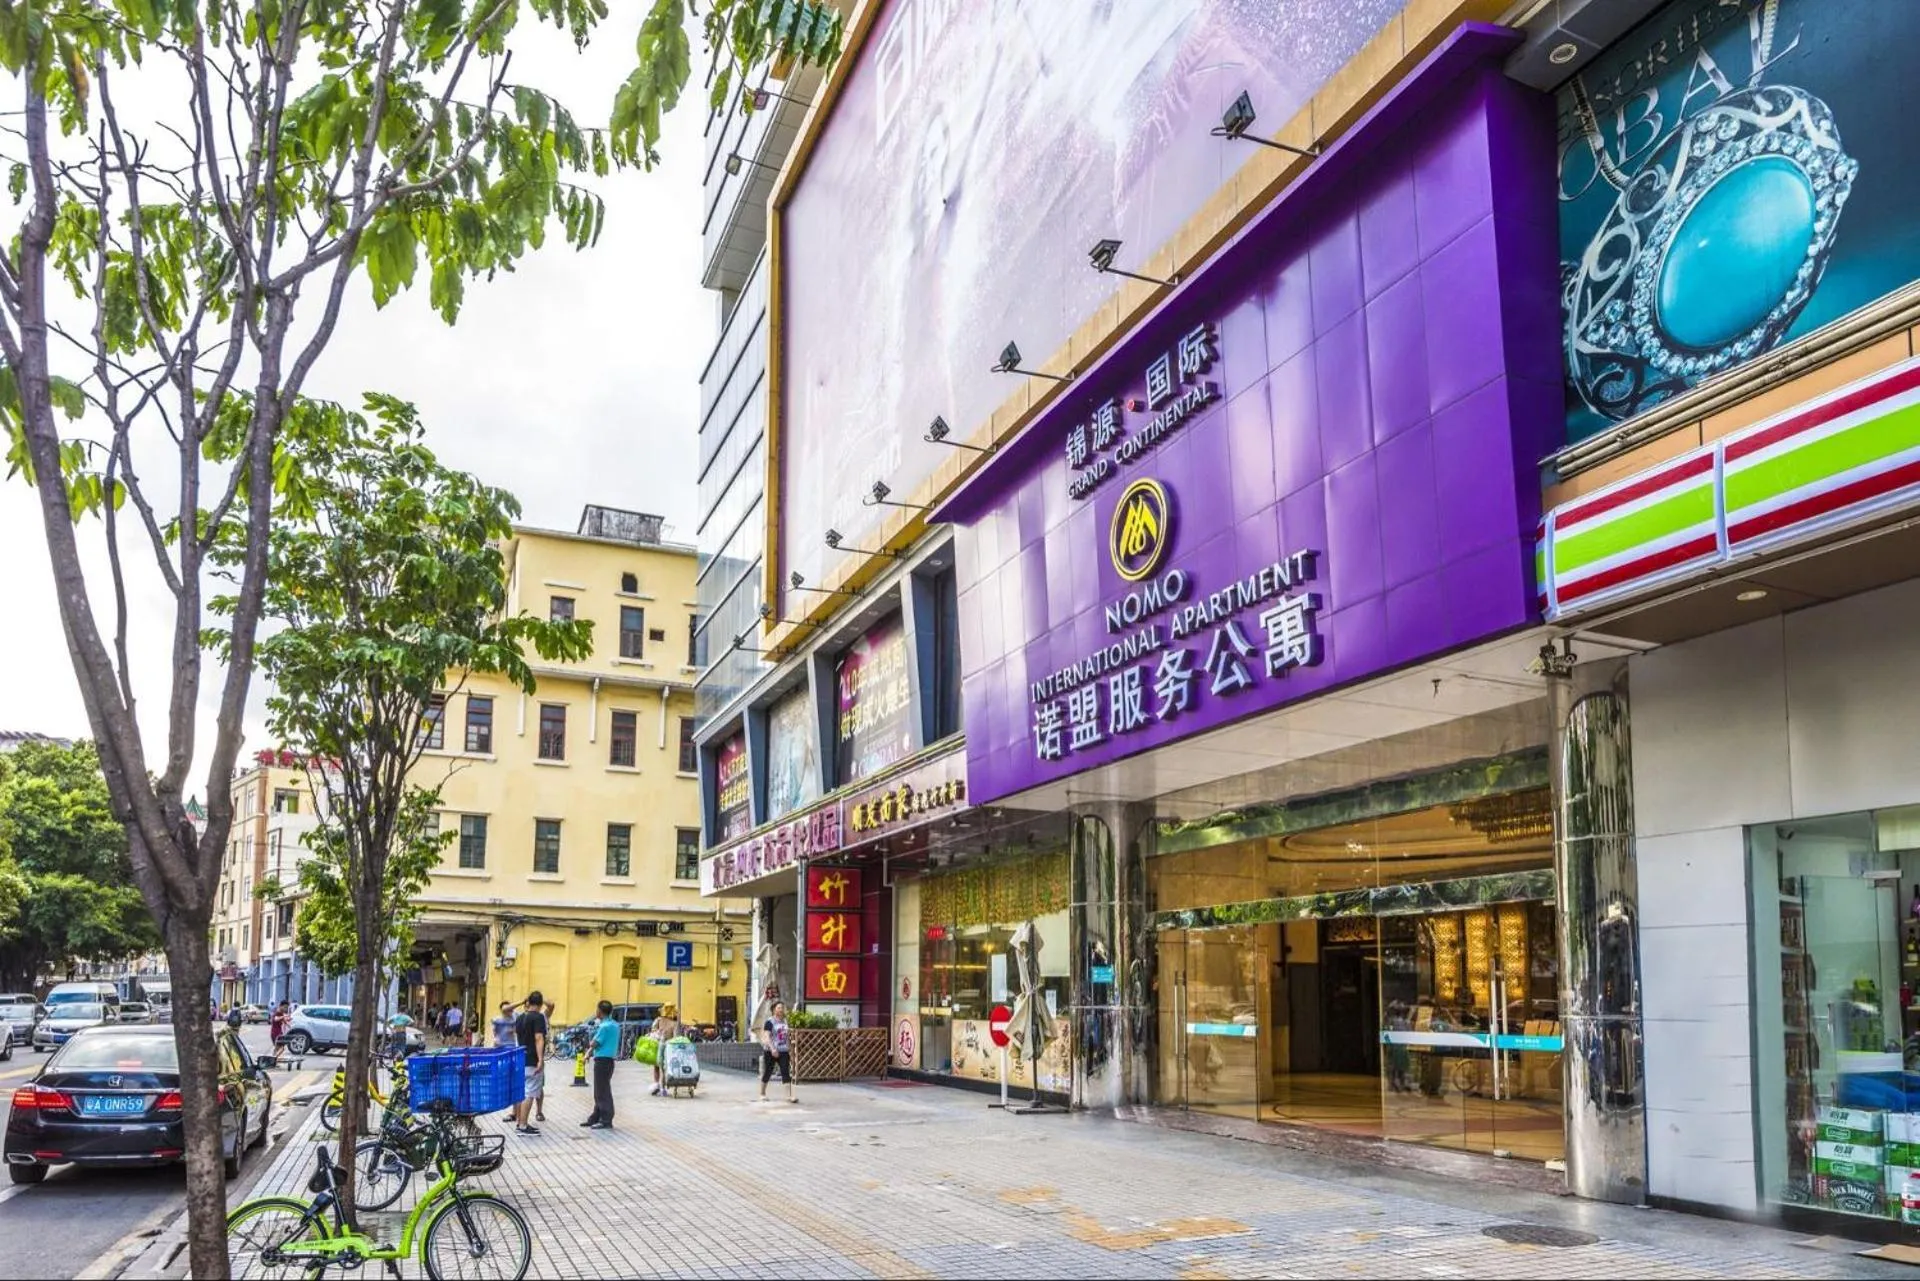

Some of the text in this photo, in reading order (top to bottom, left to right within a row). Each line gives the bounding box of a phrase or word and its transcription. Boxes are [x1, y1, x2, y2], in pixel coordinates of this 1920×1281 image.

[1067, 382, 1216, 499] GRAND CONTINENTAL
[1031, 549, 1319, 703] INTERNATIONAL APARTMENT
[1105, 569, 1188, 634] NOMO
[1033, 594, 1322, 760] 诺盟服务公寓
[673, 946, 686, 963] P
